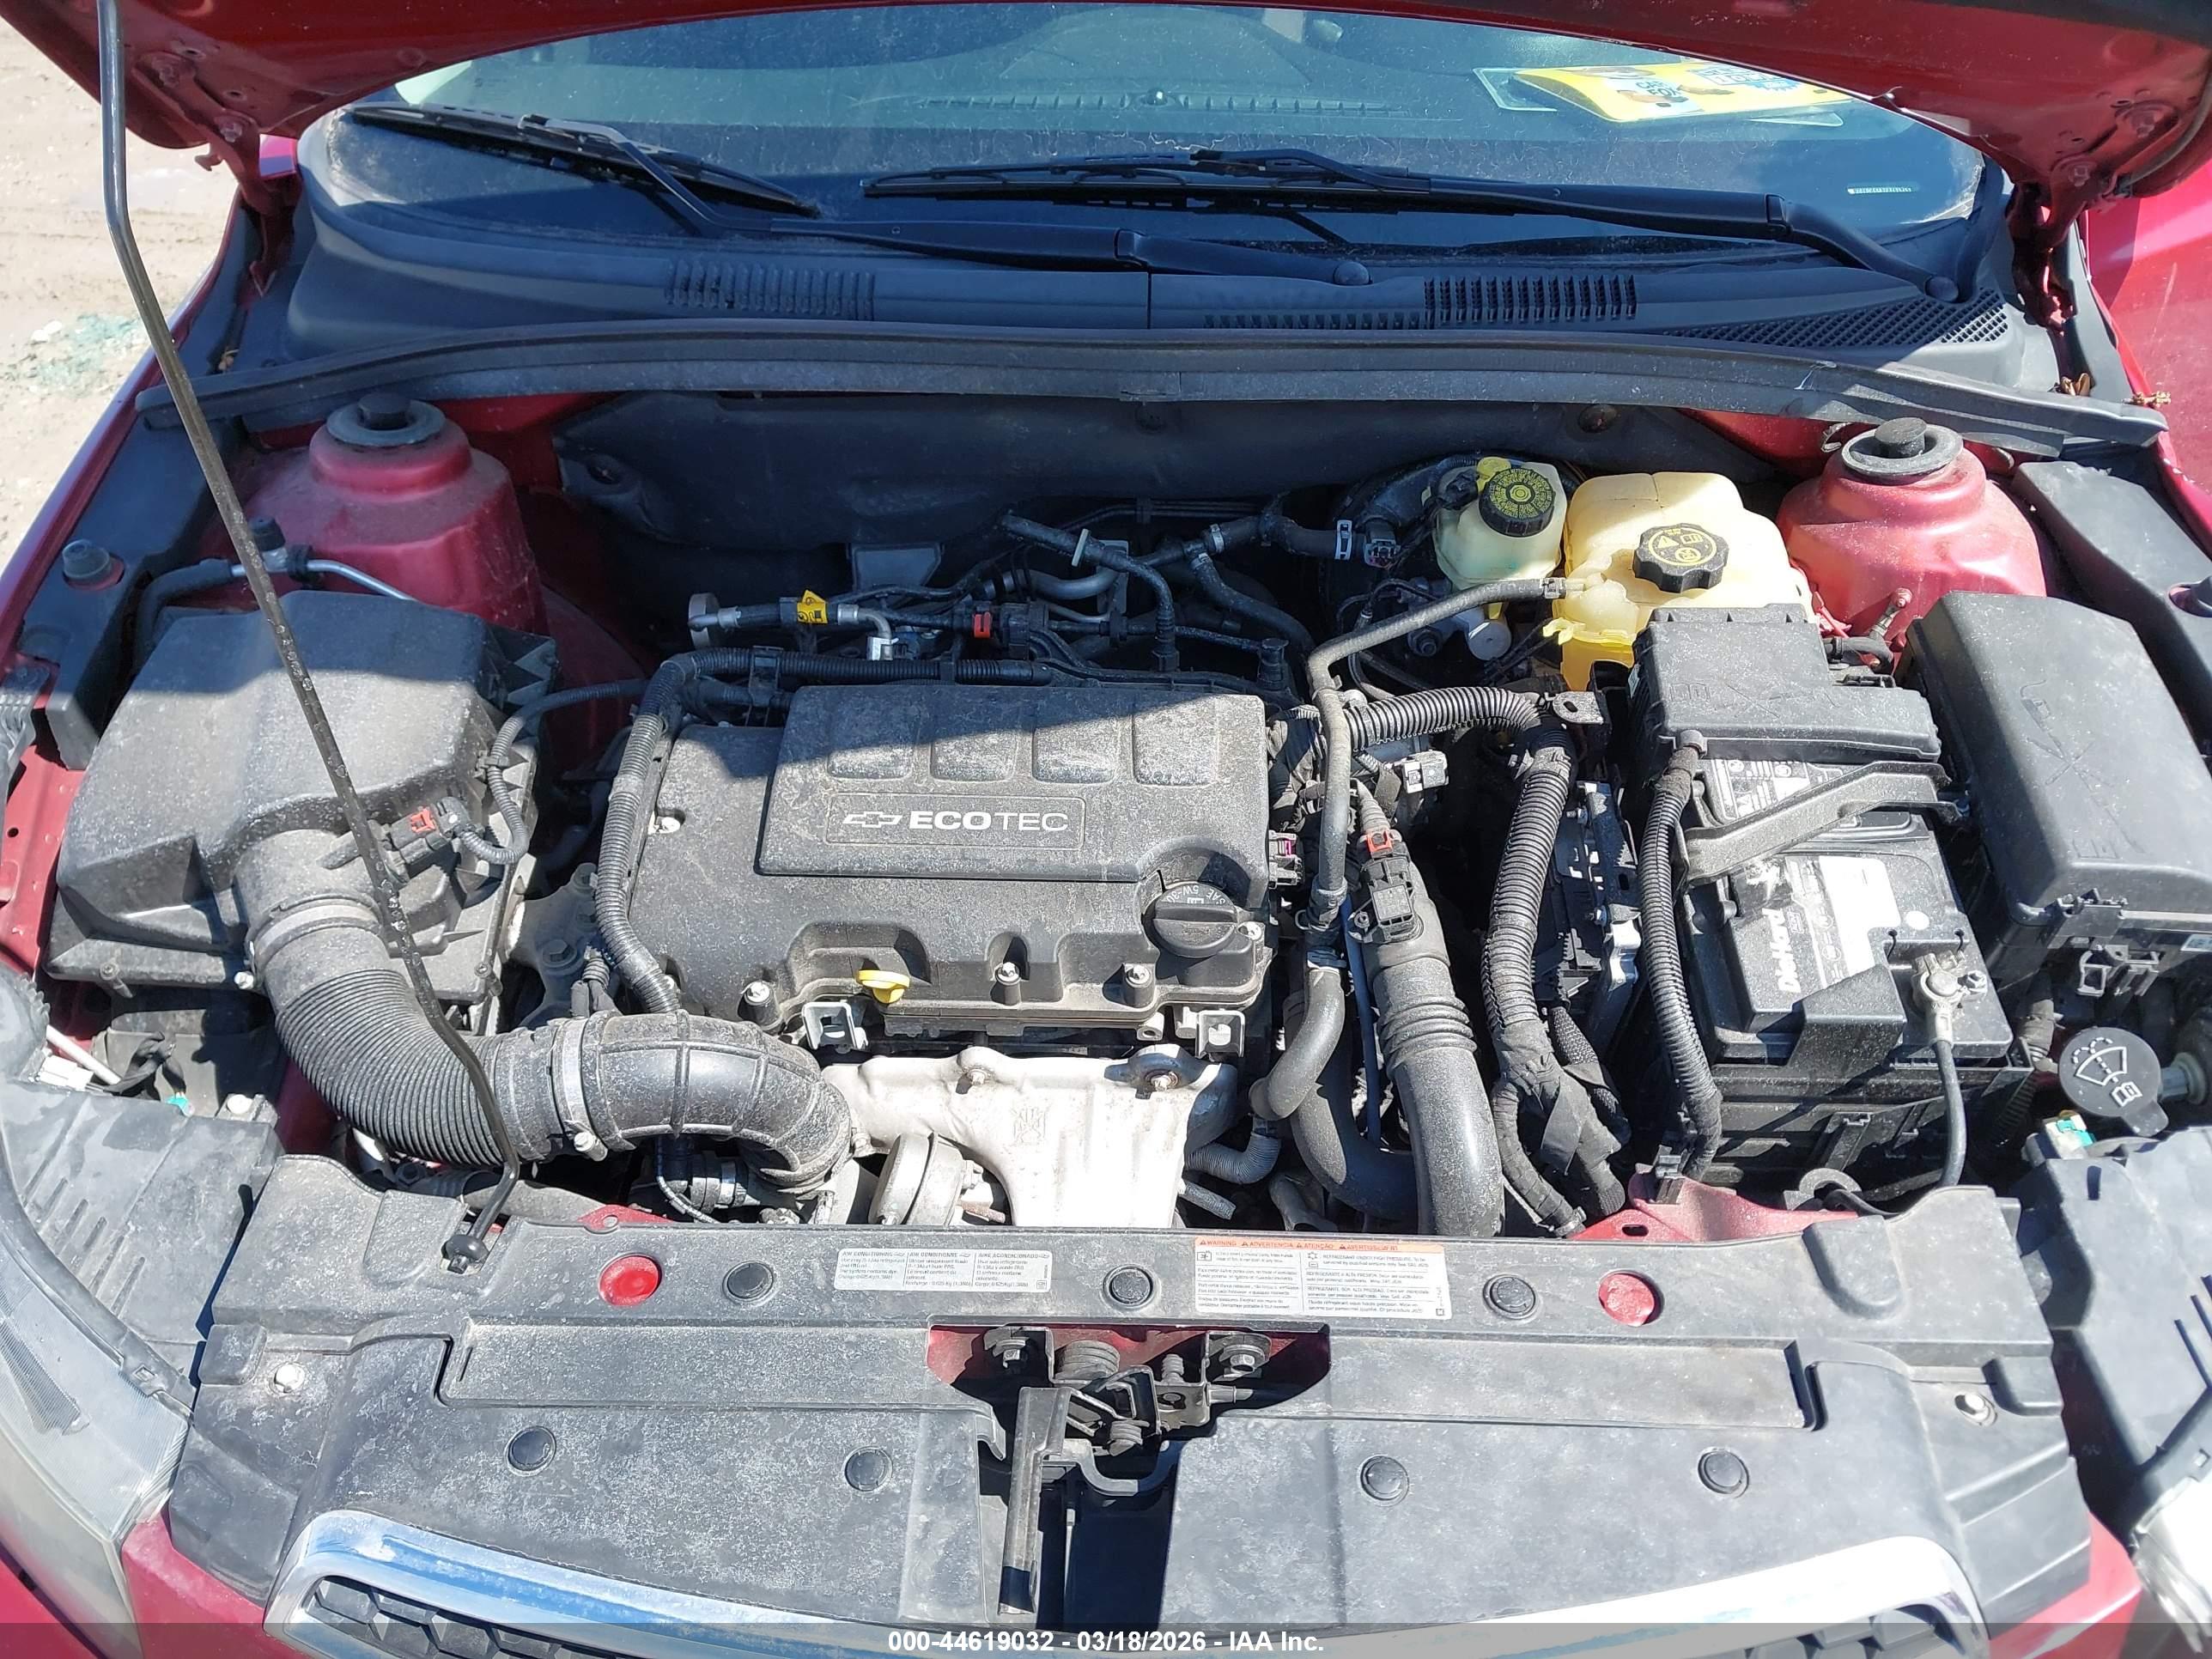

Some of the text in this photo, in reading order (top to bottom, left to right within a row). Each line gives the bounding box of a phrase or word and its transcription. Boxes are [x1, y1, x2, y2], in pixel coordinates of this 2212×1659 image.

[909, 810, 1069, 832] ECOTEC
[1166, 884, 1199, 903] 5W-30
[1762, 908, 1802, 994] DieHard
